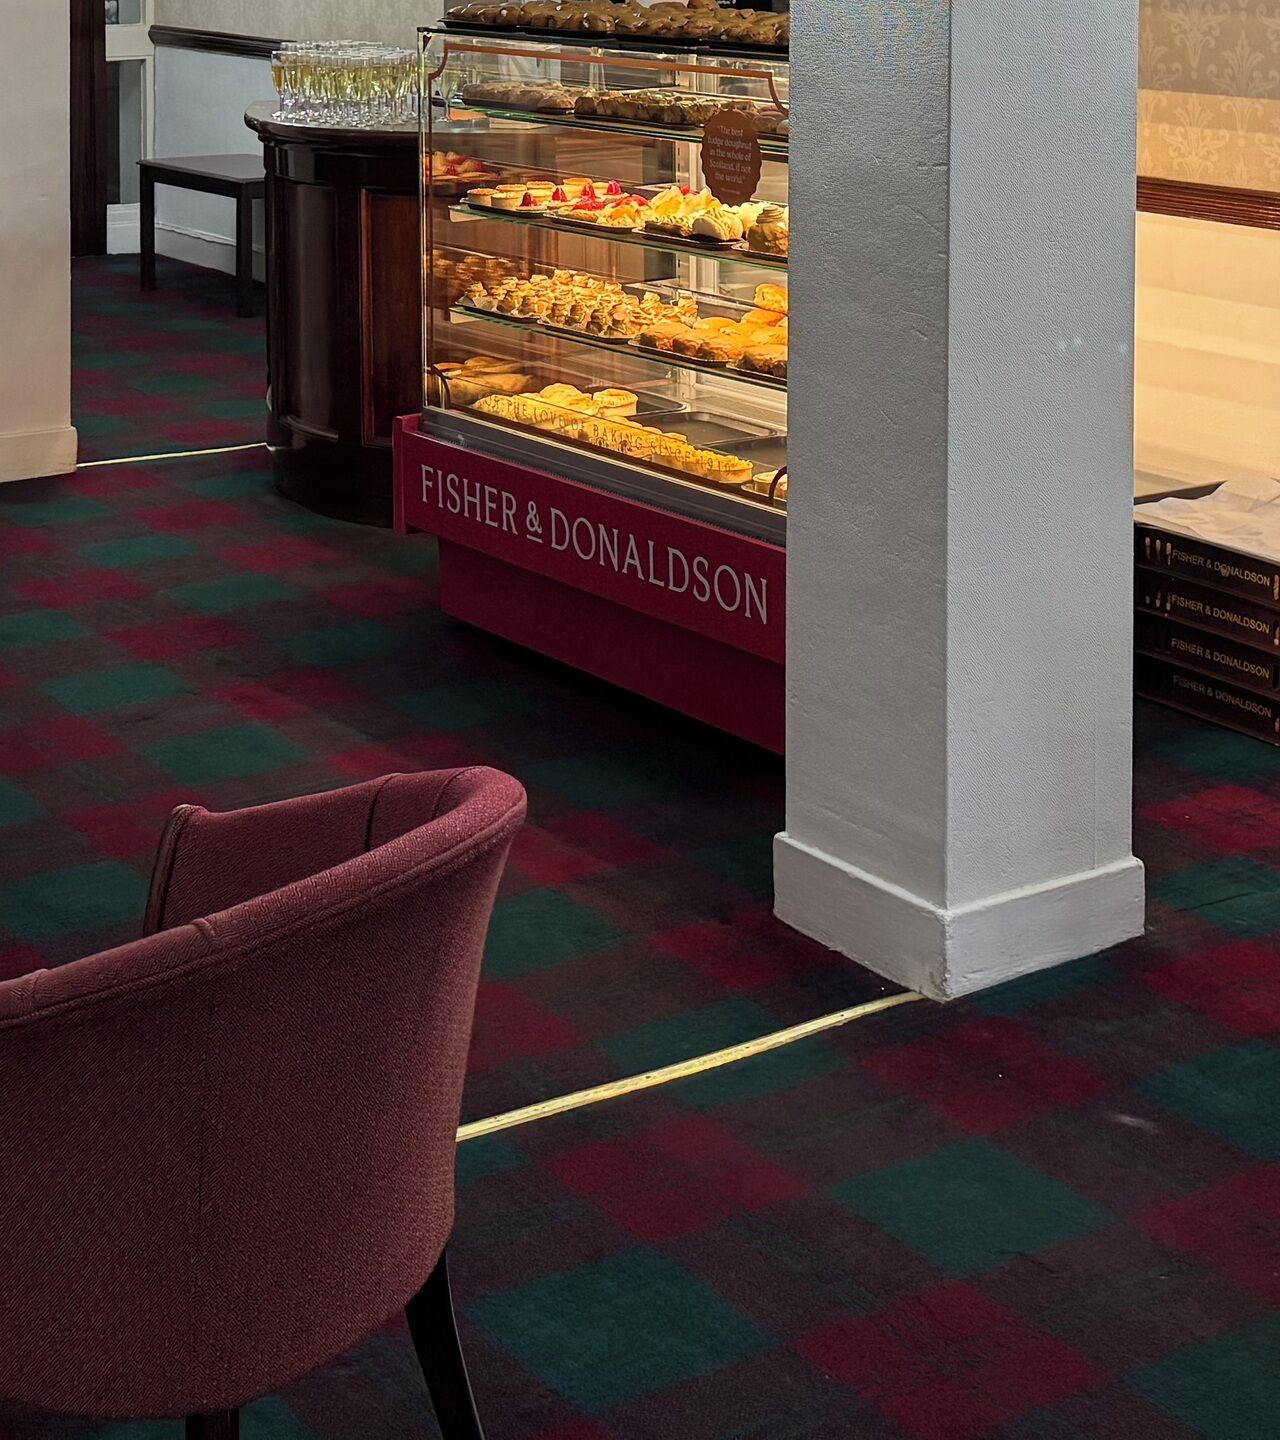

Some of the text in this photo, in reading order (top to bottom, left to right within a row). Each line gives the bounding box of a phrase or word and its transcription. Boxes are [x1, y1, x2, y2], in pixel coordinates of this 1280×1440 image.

[593, 424, 642, 450] BAKING
[650, 440, 690, 462] SINCE
[420, 464, 768, 625] FISHER & DONALDSON
[1172, 549, 1270, 586] FISHER & DONALDSON
[1171, 594, 1270, 635] FISHER & DONALDSON
[1171, 638, 1270, 679] FISHER & DONALDSON
[1173, 675, 1272, 718] FISHER & DONALDSON
